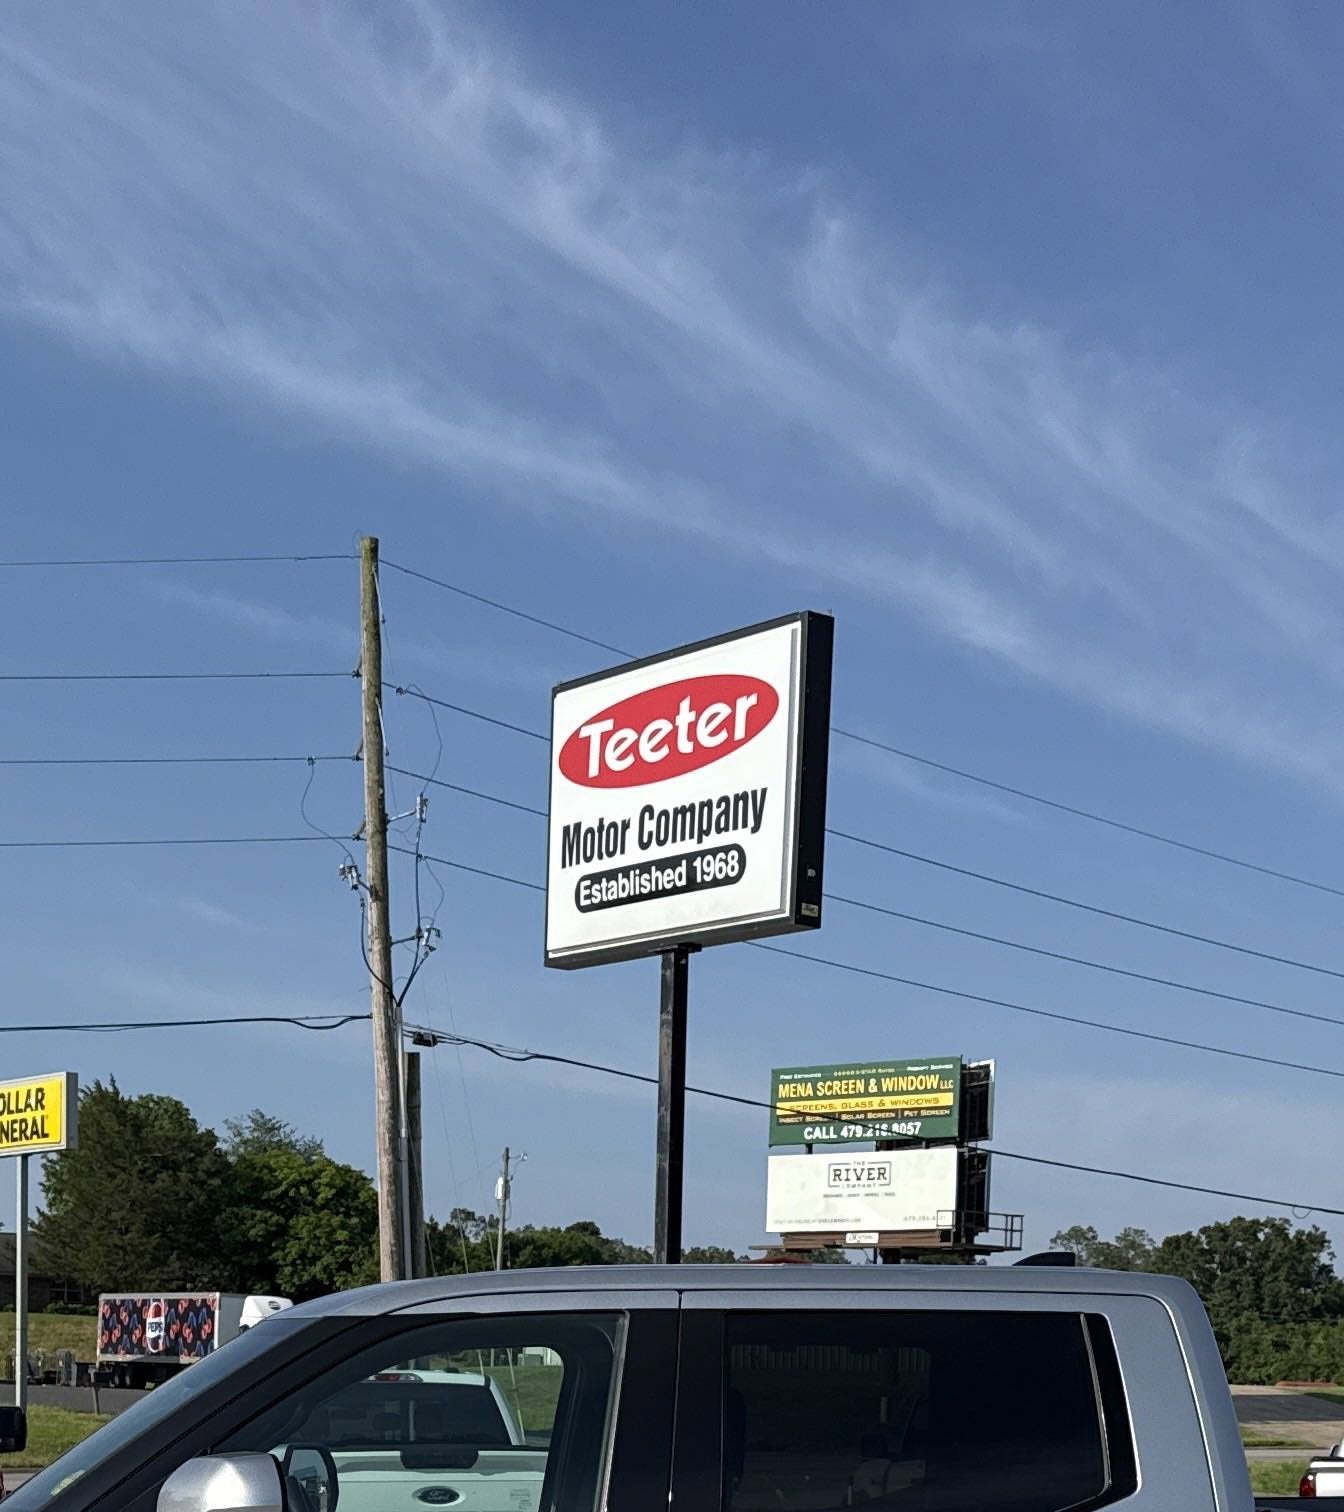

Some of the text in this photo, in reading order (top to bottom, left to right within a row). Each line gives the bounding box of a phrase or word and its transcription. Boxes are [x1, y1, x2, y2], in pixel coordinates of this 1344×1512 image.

[578, 693, 759, 780] Teeter
[561, 787, 768, 869] Motor Company
[579, 850, 739, 906] Established 1968
[778, 1082, 814, 1098] MENA
[816, 1079, 865, 1096] SCREEN
[868, 1077, 878, 1093] &
[881, 1073, 940, 1092] WINDOW
[890, 1097, 940, 1106] WINDOWS
[803, 1126, 838, 1140] CALL
[832, 1167, 888, 1181] RIVER
